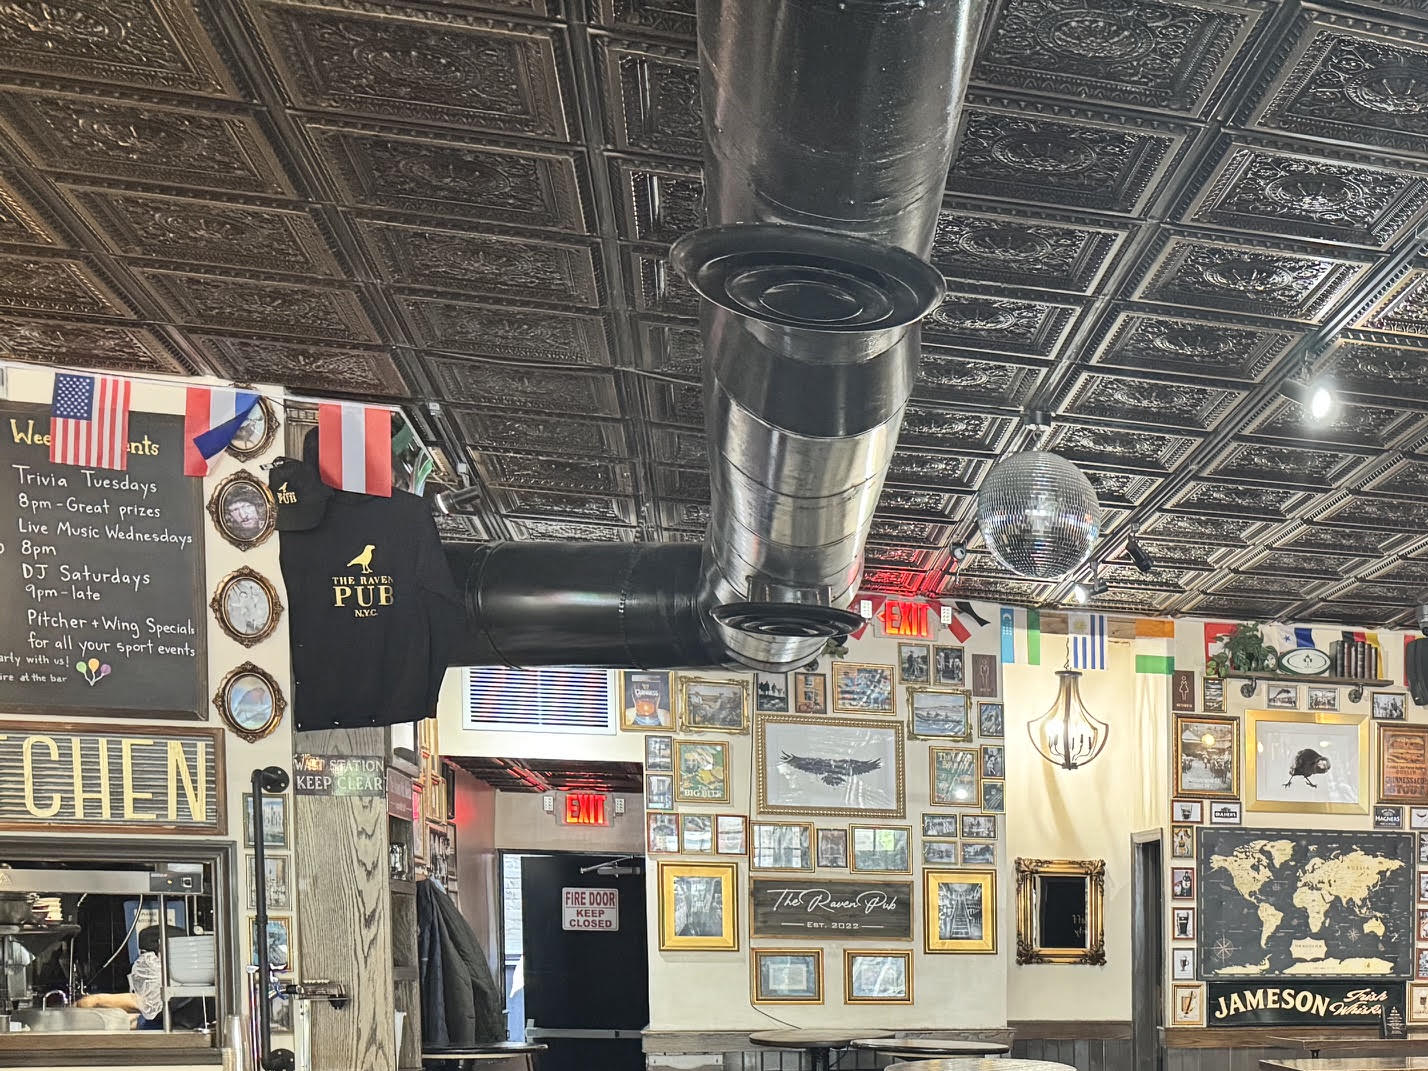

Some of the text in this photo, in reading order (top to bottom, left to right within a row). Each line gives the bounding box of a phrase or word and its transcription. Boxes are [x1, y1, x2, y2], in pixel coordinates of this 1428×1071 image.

[10, 419, 160, 455] Wee nts
[12, 464, 157, 499] Trivia Tuesdays
[18, 492, 160, 520] 8pm Great prizes
[19, 518, 193, 551] Live Music Wednesdays
[21, 540, 57, 560] 8pm
[22, 562, 151, 592] DJ Saturdays
[332, 576, 394, 585] THE RAVEN
[25, 584, 101, 602] 9pm late
[333, 585, 394, 607] PUB
[27, 609, 88, 629] Pitcher
[101, 616, 140, 639] Wing
[146, 617, 195, 639] Specials
[885, 600, 930, 636] EXIT
[27, 631, 196, 658] for all your sport events
[0, 652, 70, 668] arty with us!
[20, 673, 68, 683] at the bar
[329, 760, 385, 774] STATION
[0, 735, 207, 822] CHEN
[296, 776, 383, 791] KEEP CLEAR
[566, 794, 607, 824] EXIT
[565, 891, 616, 907] FIRE DOOR
[767, 888, 897, 914] The Raven Pub
[569, 919, 612, 928] CLOSED
[576, 909, 605, 918] KEEP
[831, 922, 860, 930] 2022
[1215, 988, 1389, 1019] JAMESON Irish
[1329, 1001, 1382, 1017] Whiske
